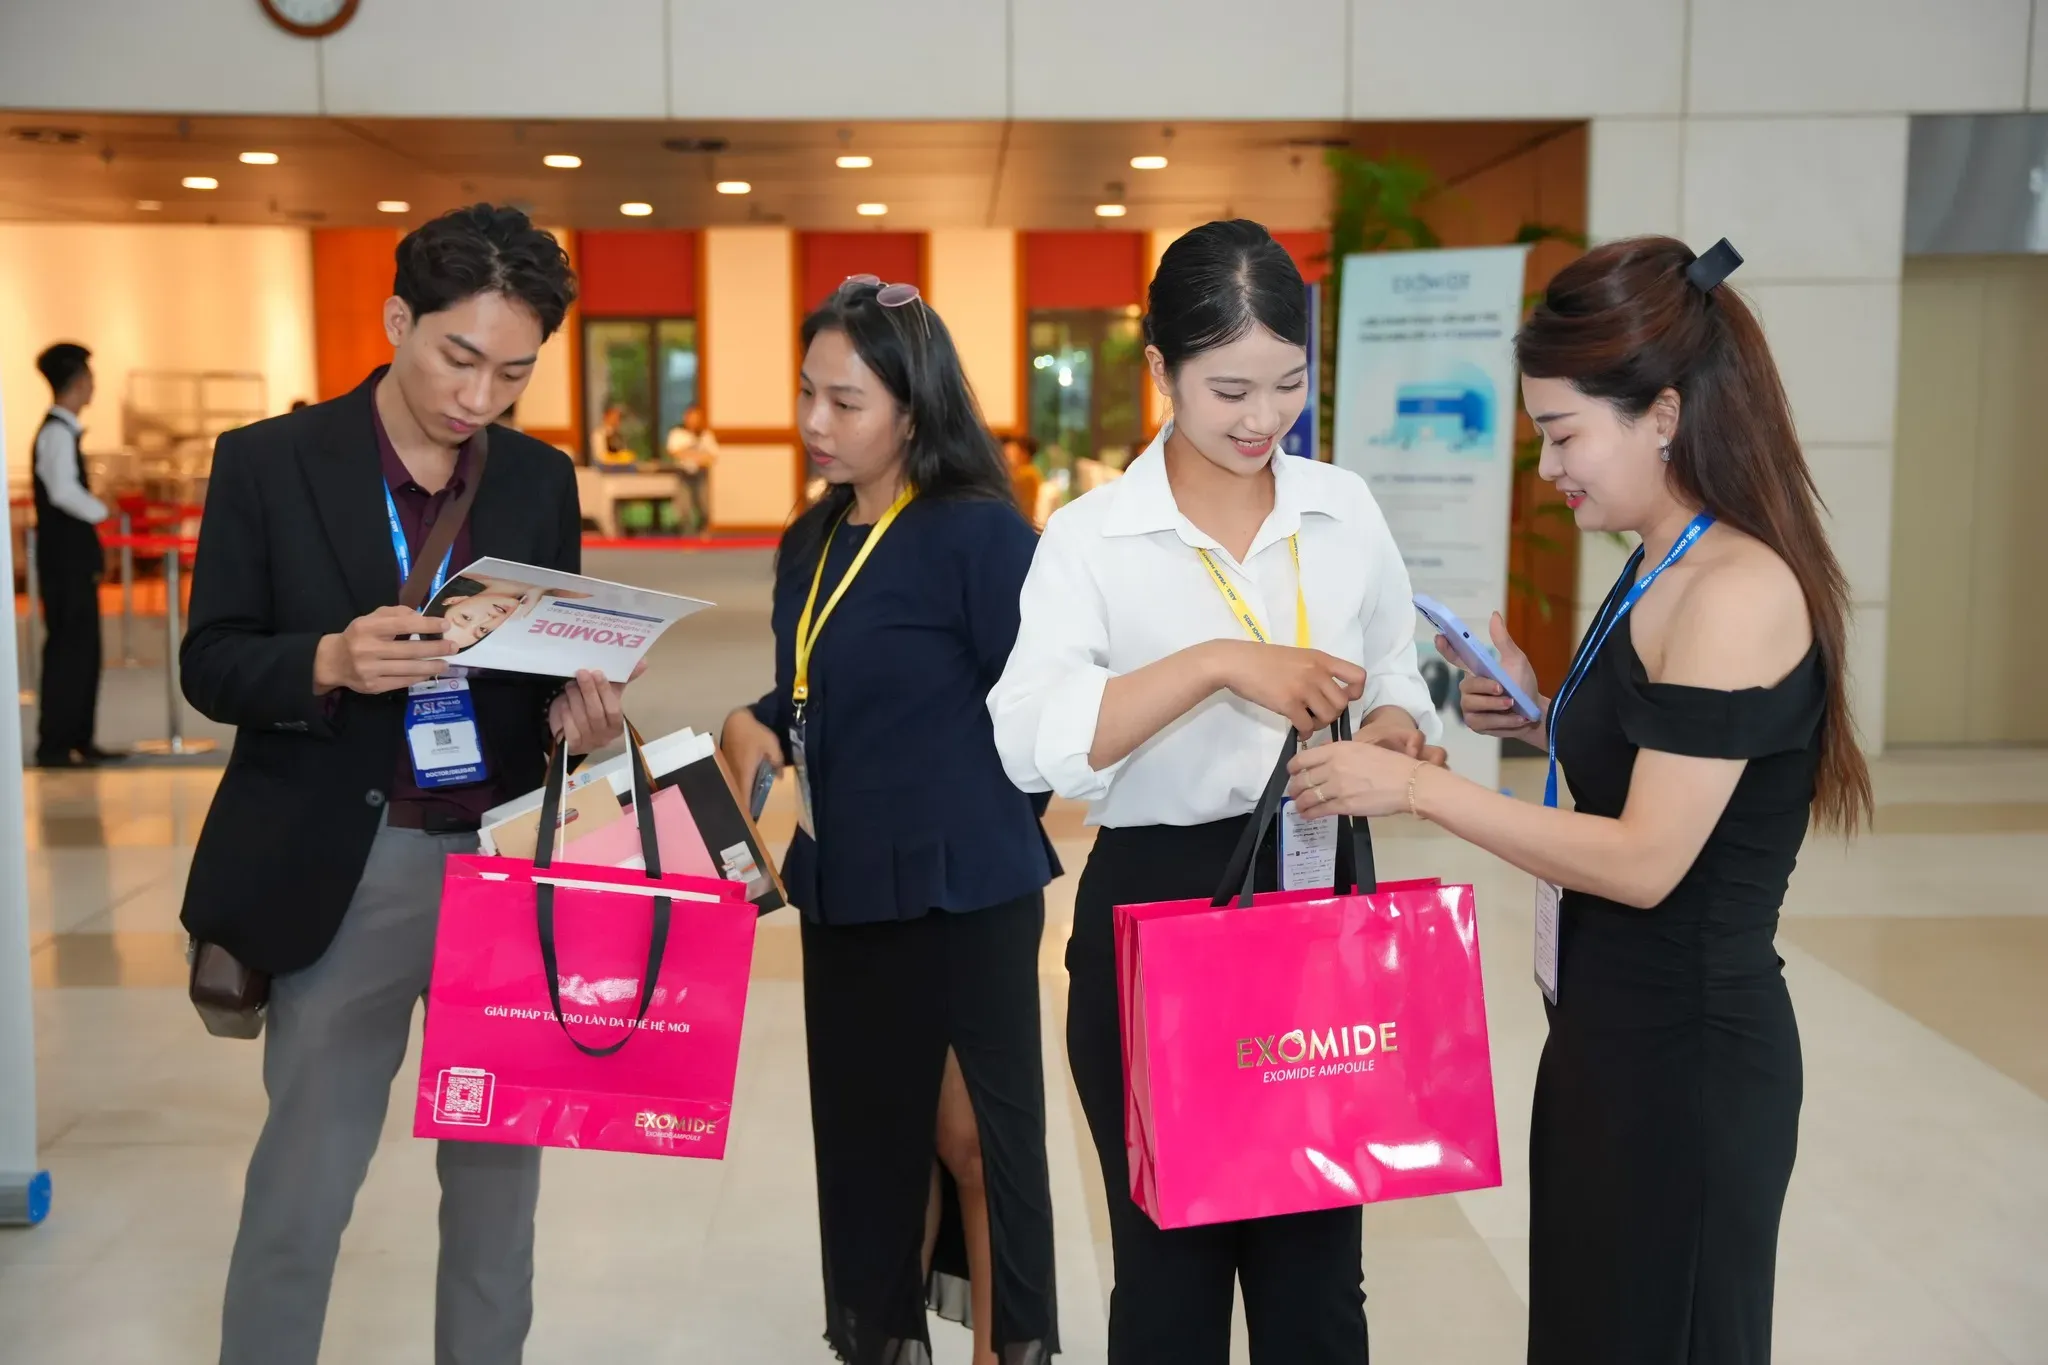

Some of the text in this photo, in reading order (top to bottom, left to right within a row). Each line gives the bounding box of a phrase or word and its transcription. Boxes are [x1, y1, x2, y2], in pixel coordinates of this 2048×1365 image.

[1671, 538, 1688, 558] HANOI
[1686, 525, 1701, 540] 2025
[529, 619, 646, 649] EXOMIDE
[510, 1008, 540, 1020] PHÁP
[543, 1010, 559, 1022] TÁ
[561, 1012, 583, 1025] TẠO
[585, 1014, 607, 1026] LÀN
[609, 1017, 624, 1027] DA
[650, 1020, 666, 1033] HỆ
[668, 1022, 690, 1033] MỚI
[1236, 1022, 1398, 1069] EXOMIDE
[1263, 1059, 1375, 1083] EXOMIDE AMPOULE
[634, 1112, 717, 1135] EXOMIDE
